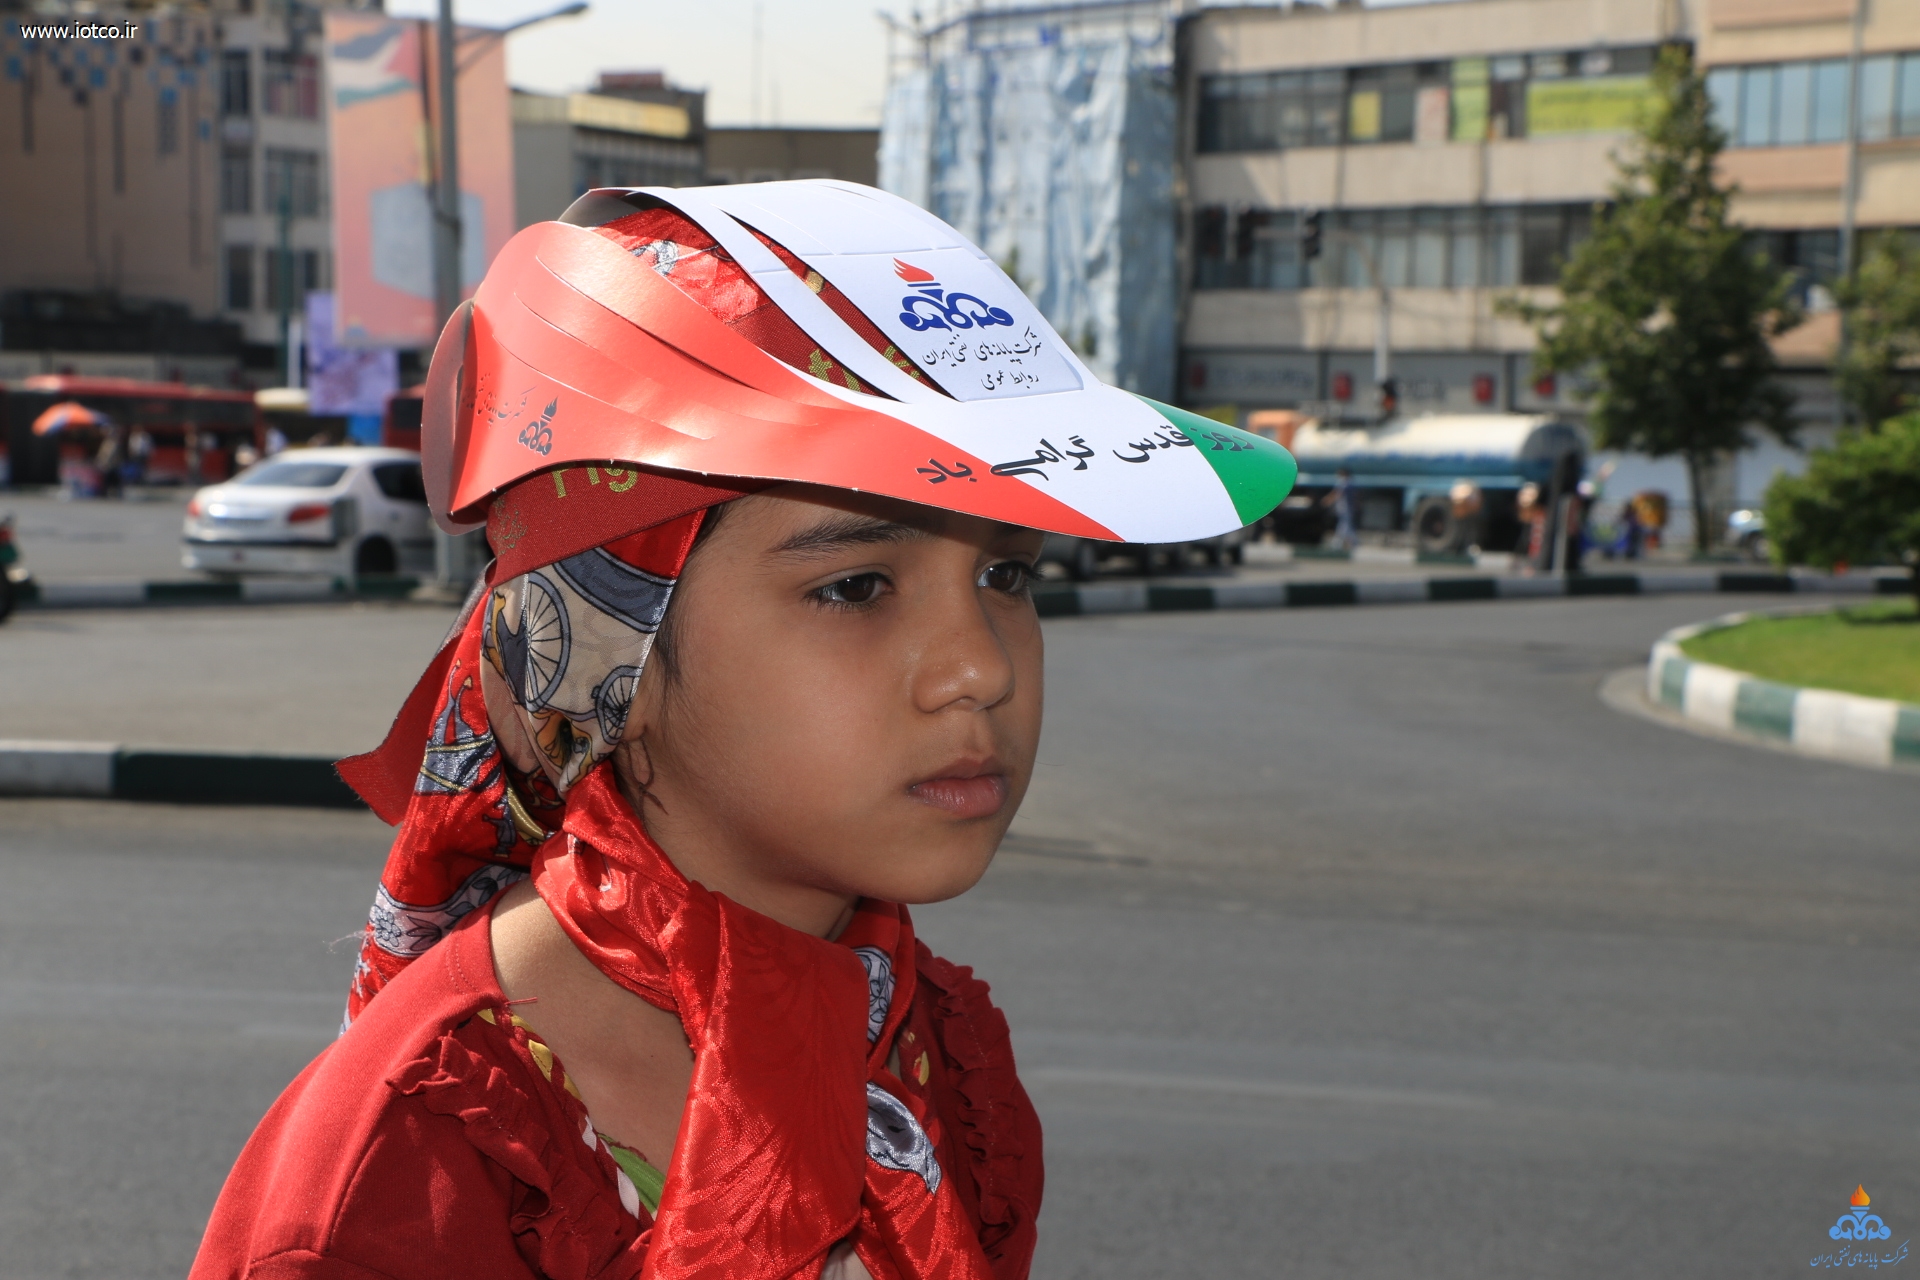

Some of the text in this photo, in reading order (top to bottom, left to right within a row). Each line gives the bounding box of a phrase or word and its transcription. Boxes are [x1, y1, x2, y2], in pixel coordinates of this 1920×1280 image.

[1013, 325, 1042, 357] شرکت
[980, 369, 1040, 391] روابط عمومی
[915, 424, 1256, 485] روز قدس گرامی باد
